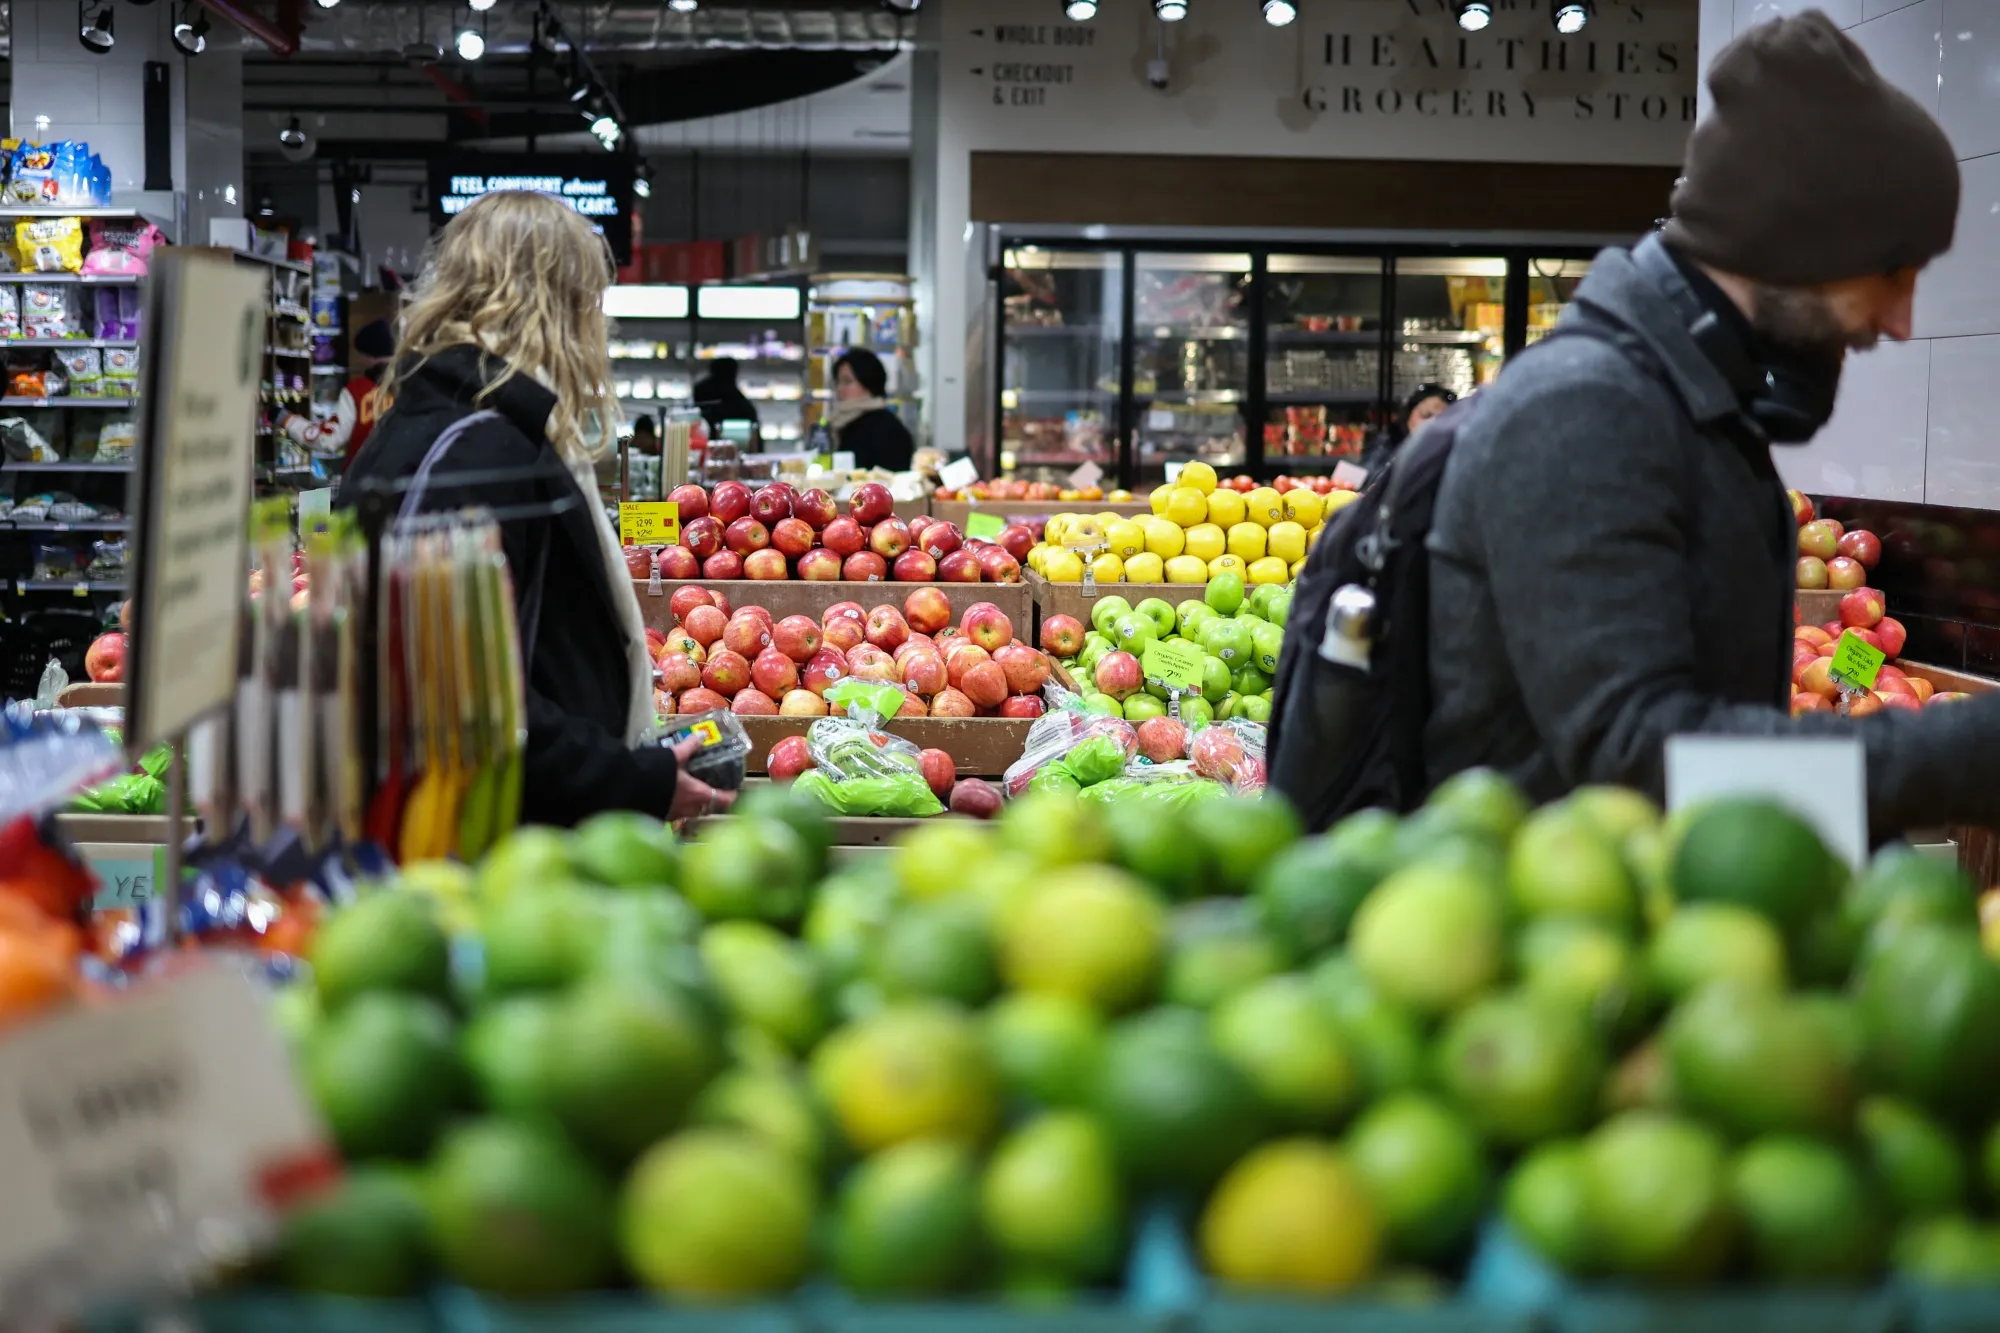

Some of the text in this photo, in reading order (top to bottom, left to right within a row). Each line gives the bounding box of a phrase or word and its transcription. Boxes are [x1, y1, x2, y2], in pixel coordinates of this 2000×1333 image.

[994, 26, 1096, 46] WHOLE BODY
[1324, 33, 1698, 73] HEALTHIES
[993, 63, 1074, 83] CHECKOUT
[993, 86, 1045, 106] & EXIT
[1303, 86, 1538, 118] GROCERY
[451, 176, 606, 195] FEEL CONFIDENT about
